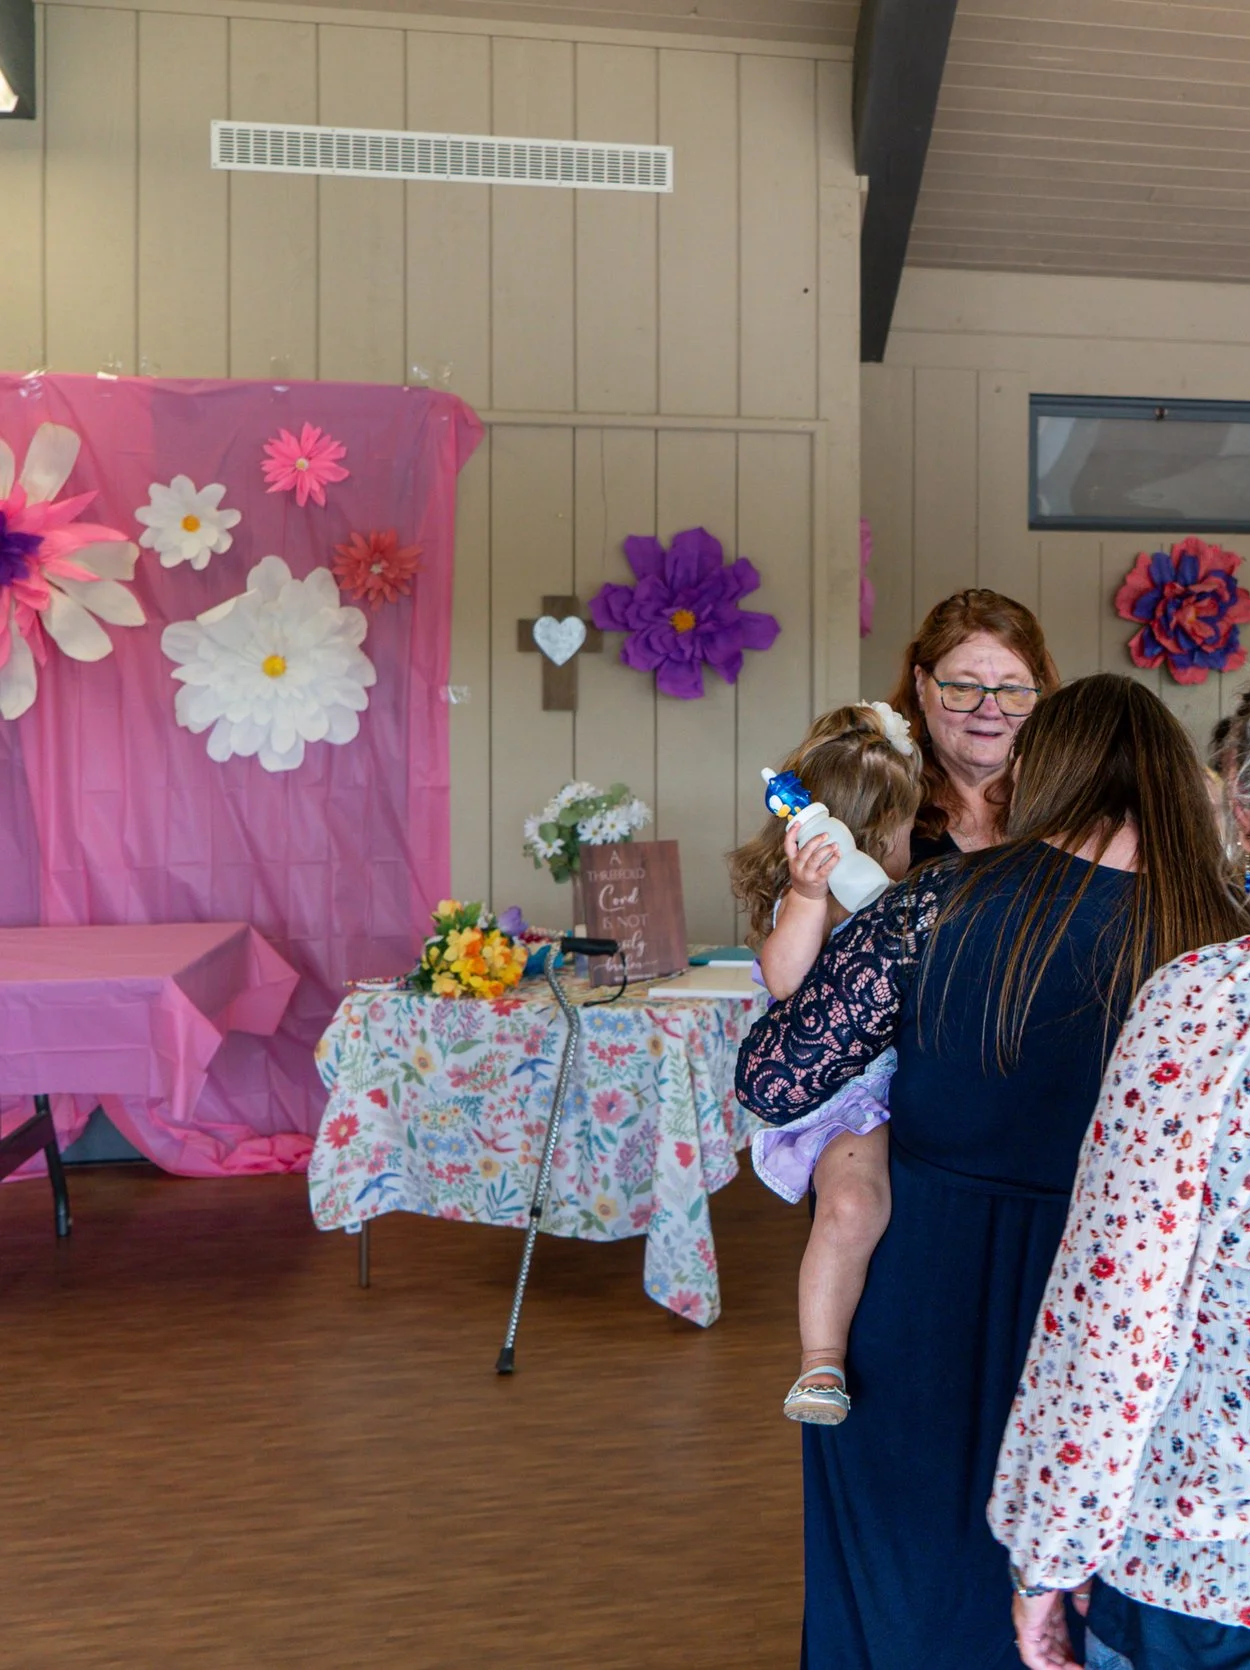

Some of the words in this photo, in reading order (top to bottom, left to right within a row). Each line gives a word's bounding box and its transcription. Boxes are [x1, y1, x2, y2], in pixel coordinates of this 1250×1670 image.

[609, 850, 621, 864] A
[587, 868, 645, 882] THREEFOLD
[598, 884, 639, 912] Cord
[603, 917, 612, 930] IS
[617, 914, 648, 927] NOT
